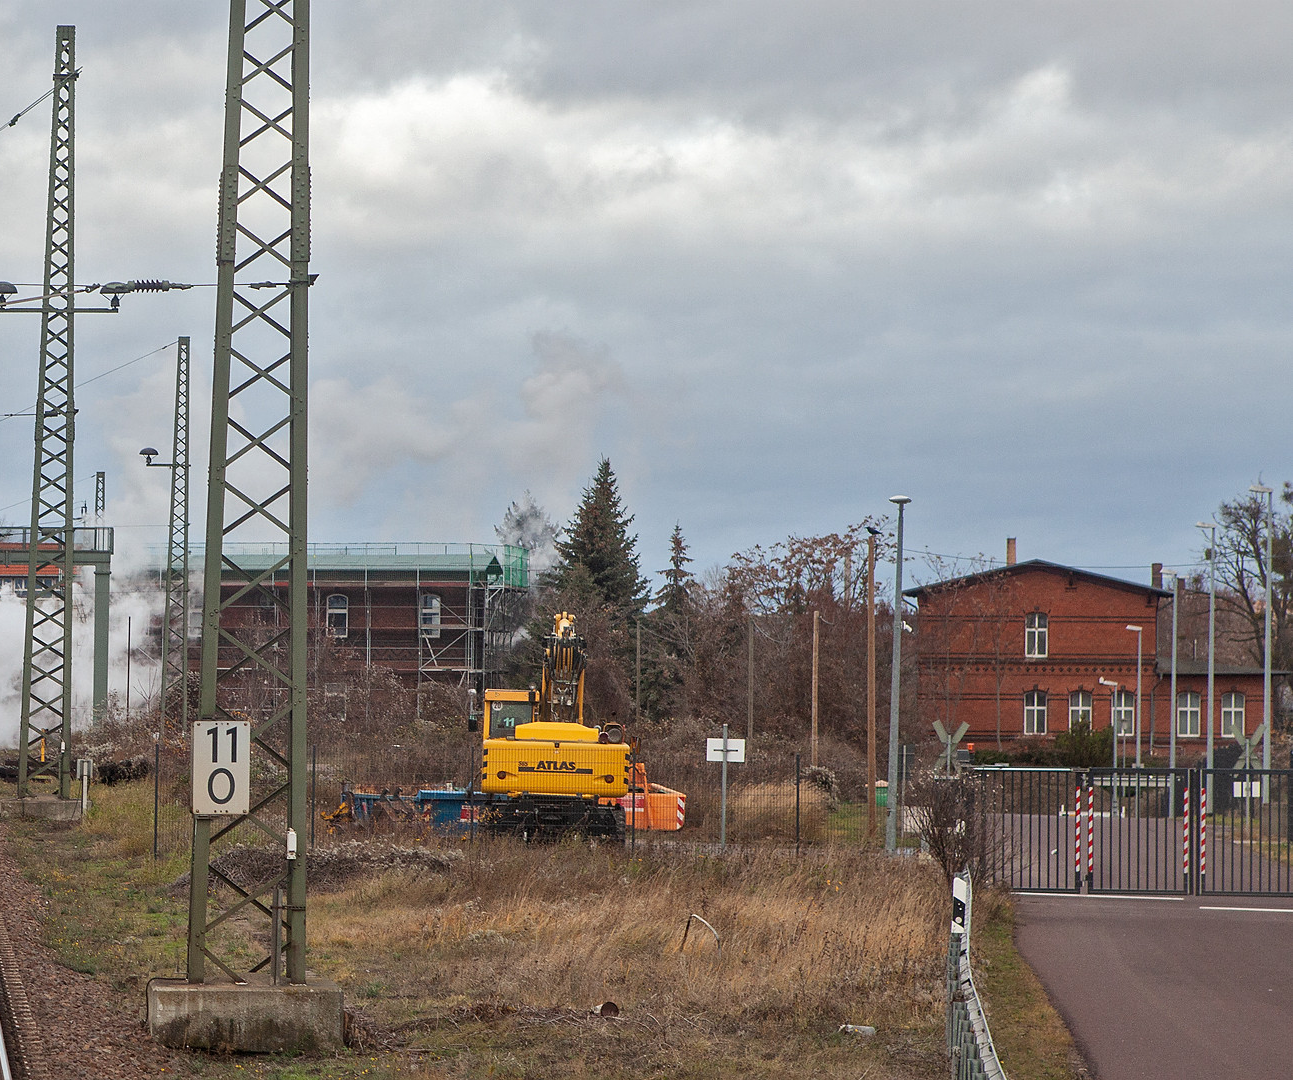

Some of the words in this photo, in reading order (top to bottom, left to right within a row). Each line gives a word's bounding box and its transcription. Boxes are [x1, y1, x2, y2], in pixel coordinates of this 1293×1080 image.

[493, 701, 502, 709] 20
[503, 717, 515, 727] 11
[207, 726, 237, 763] 11
[536, 760, 576, 771] ATLAS
[207, 767, 235, 805] 0
